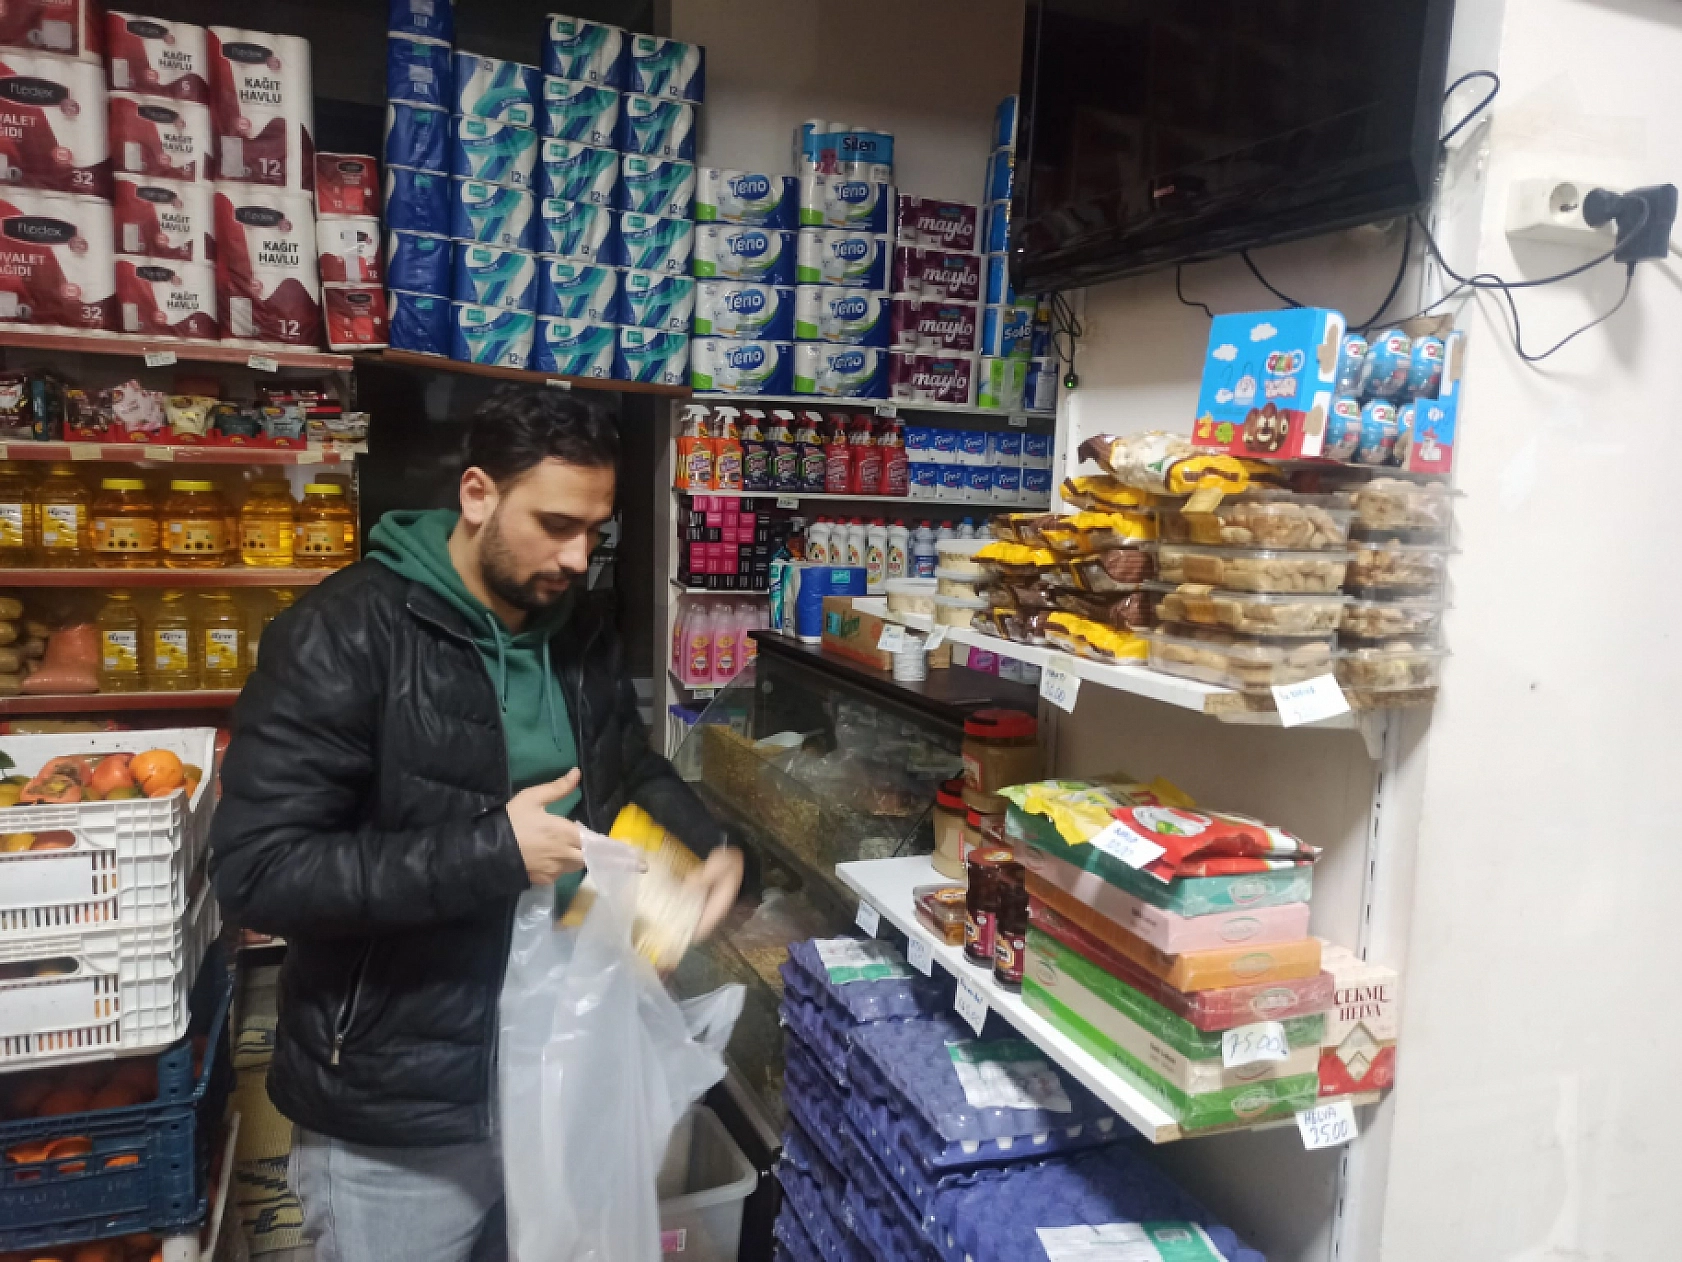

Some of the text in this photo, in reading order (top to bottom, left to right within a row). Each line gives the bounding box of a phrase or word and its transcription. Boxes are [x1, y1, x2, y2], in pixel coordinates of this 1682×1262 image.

[245, 77, 280, 90] KAĞIT
[239, 90, 282, 102] HAVLU
[842, 136, 876, 152] Silen
[259, 158, 280, 176] 12
[72, 170, 94, 184] 32
[728, 176, 766, 197] Teno
[833, 183, 866, 200] Teno
[263, 240, 298, 252] KAĞIT
[726, 233, 765, 255] Teno
[831, 240, 865, 258] Teno
[259, 252, 298, 266] HAVLU
[725, 291, 762, 312] Teno
[829, 299, 864, 318] Teno
[82, 307, 102, 319] 32
[278, 320, 300, 336] 12
[725, 348, 762, 368] Teno
[828, 355, 862, 372] Teno
